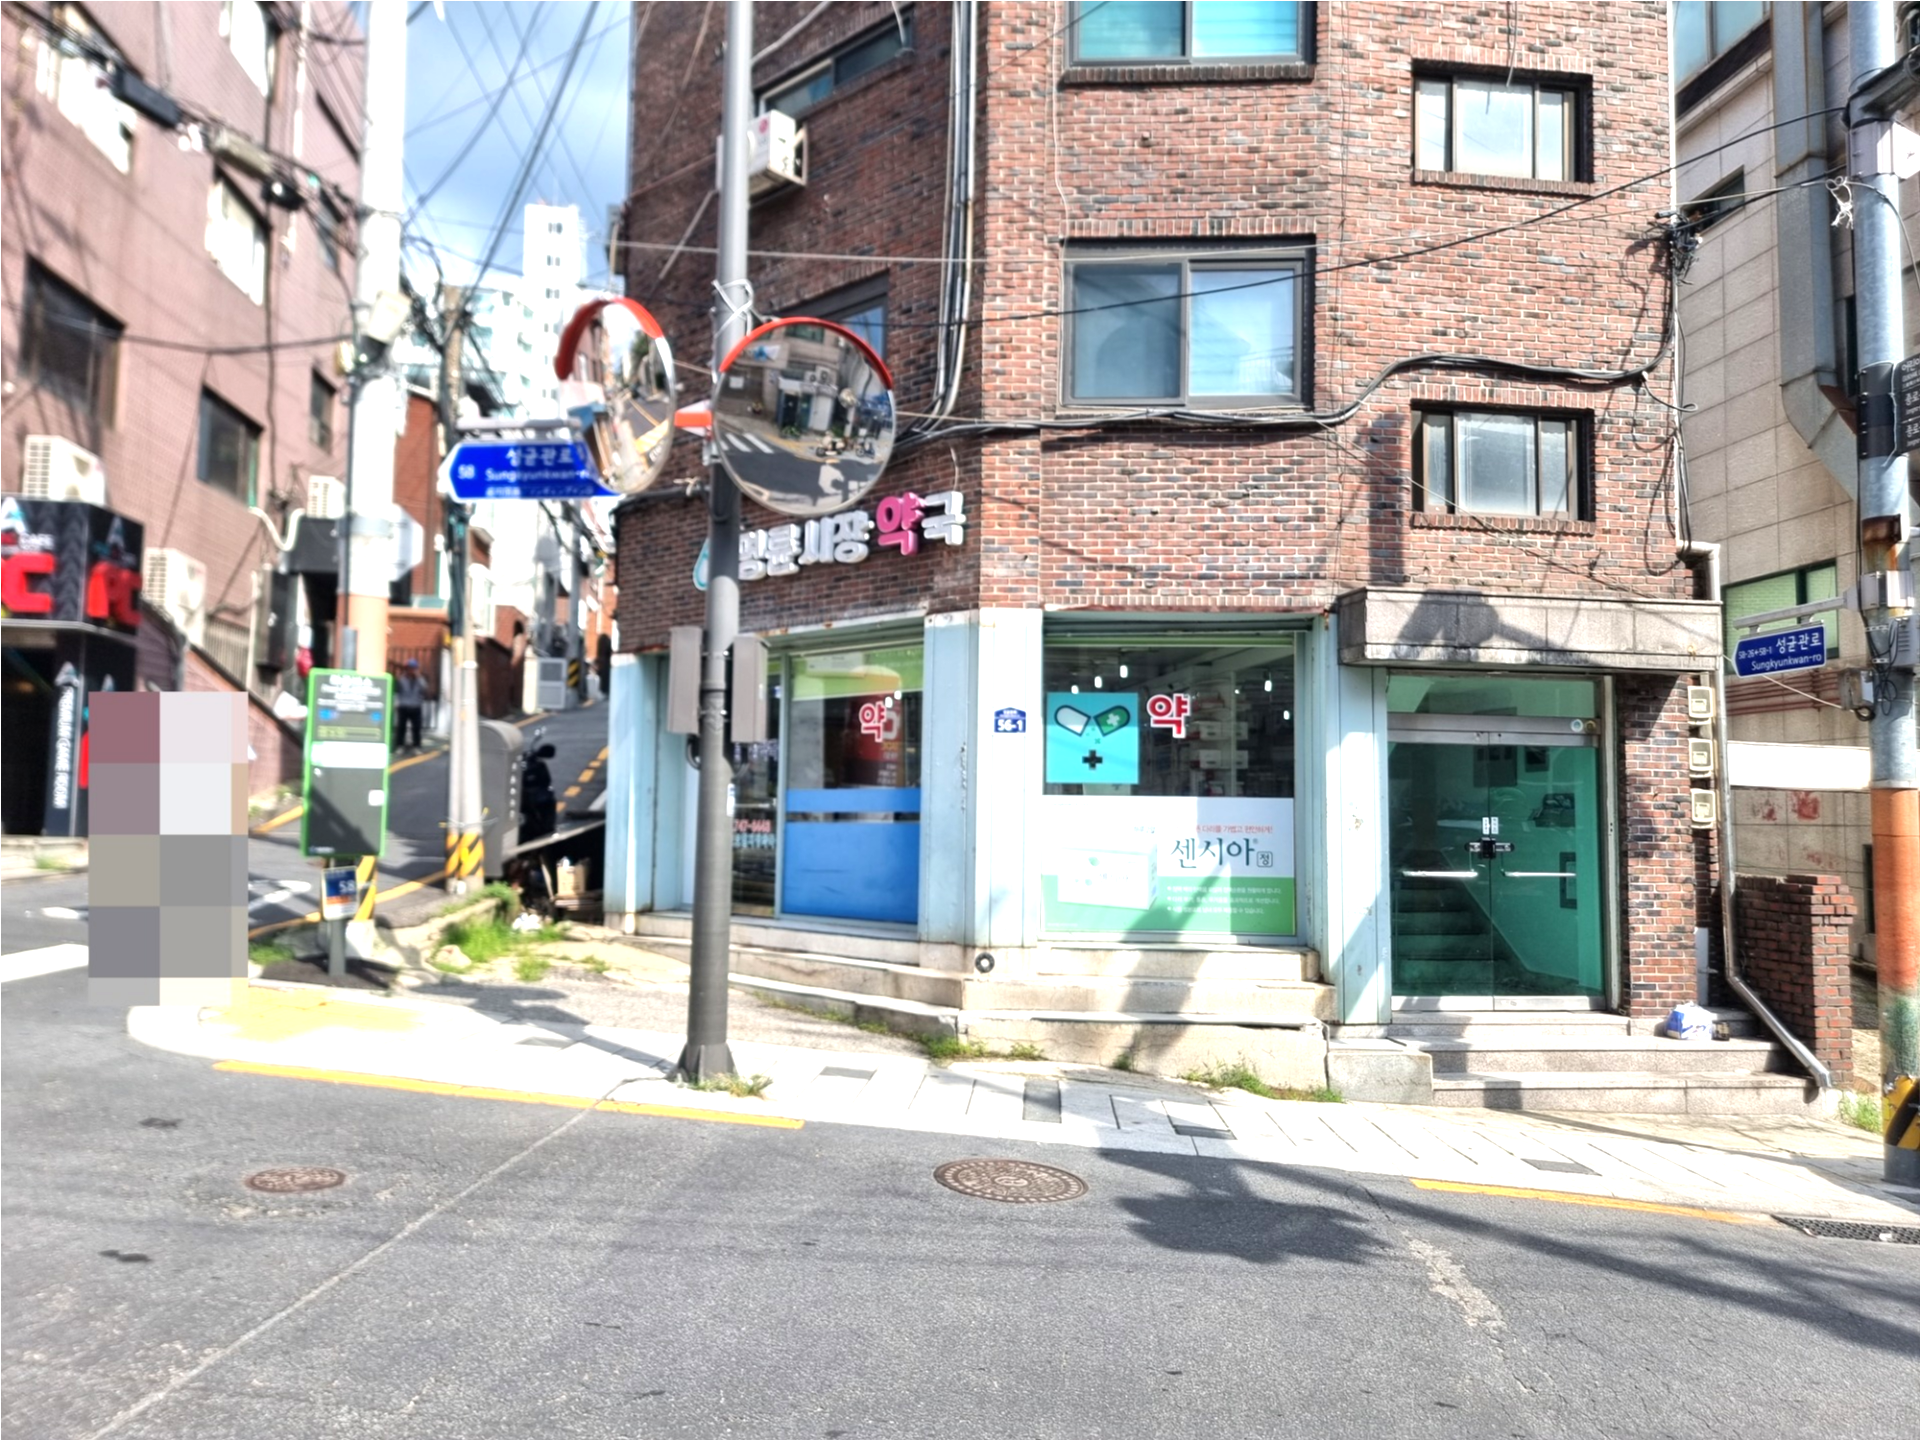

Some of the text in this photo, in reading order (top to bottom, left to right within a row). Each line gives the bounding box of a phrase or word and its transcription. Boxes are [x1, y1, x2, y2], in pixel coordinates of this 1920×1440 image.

[458, 464, 475, 479] 58
[1776, 633, 1821, 654] 성균관로
[1751, 654, 1822, 671] Sungkyunkwan-ro
[859, 701, 887, 742] 약
[998, 719, 1023, 731] 56-1
[1147, 693, 1191, 738] 약
[1223, 825, 1243, 833] 가볍고
[1171, 838, 1271, 868] 센시아 정
